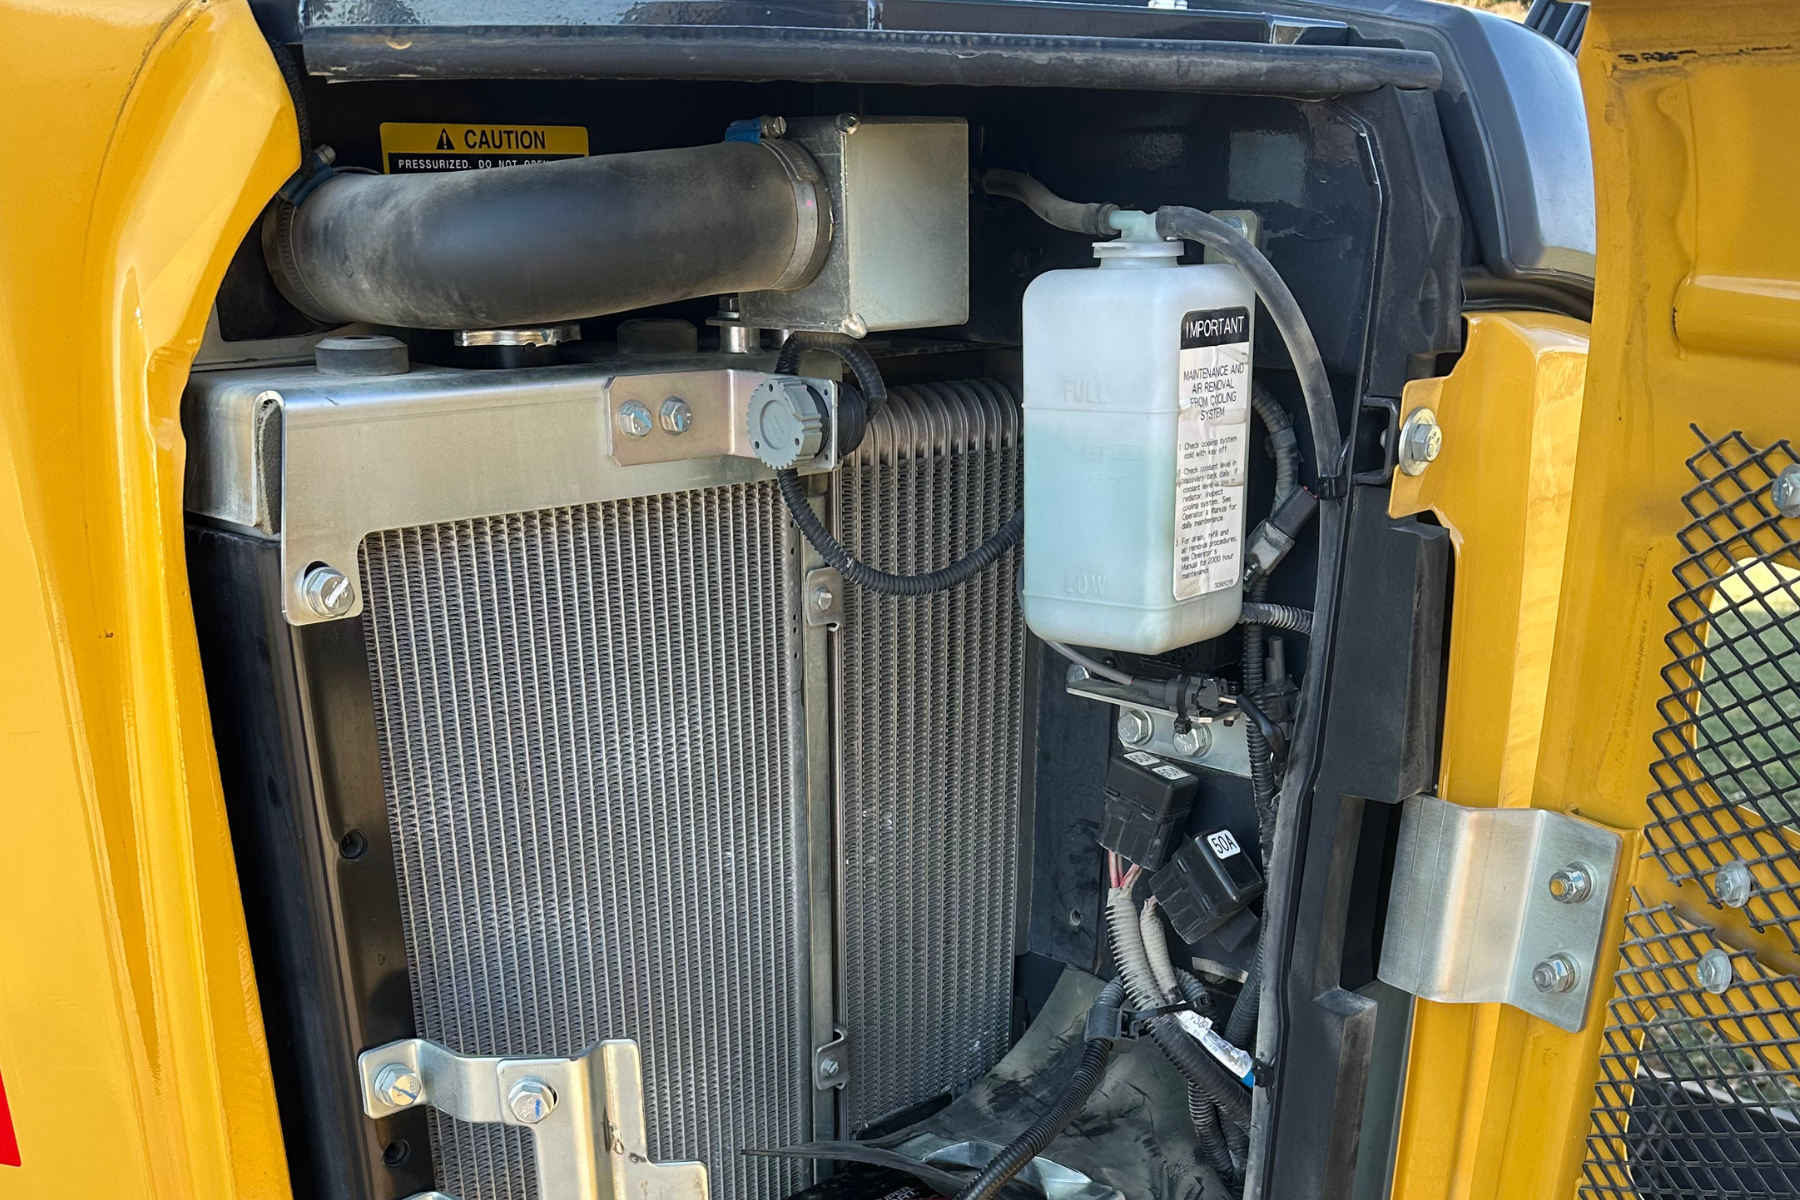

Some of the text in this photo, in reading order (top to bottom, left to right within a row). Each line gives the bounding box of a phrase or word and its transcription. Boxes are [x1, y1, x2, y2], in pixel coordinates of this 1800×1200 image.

[464, 129, 546, 149] CAUTION
[398, 159, 472, 169] PRESSURIZED.
[478, 160, 492, 169] DO
[498, 160, 518, 168] NOT
[1185, 316, 1244, 339] IMPORTANT
[1183, 363, 1244, 381] MAINTENANCE AND
[1063, 379, 1107, 404] FULL
[1192, 378, 1235, 394] AIR REMOVAL
[1190, 391, 1236, 408] FROM COOLING
[1200, 408, 1225, 421] SYSTEM
[1184, 442, 1199, 450] Check
[1201, 438, 1218, 447] cooling
[1220, 436, 1237, 444] system
[1184, 451, 1194, 459] cold
[1196, 449, 1206, 457] with
[1183, 467, 1198, 475] Check
[1200, 463, 1218, 472] coolant
[1183, 484, 1200, 494] coolant
[1182, 502, 1199, 512] cooling
[1211, 505, 1227, 514] Manual
[1182, 521, 1192, 529] daily
[1181, 537, 1190, 545] For
[1220, 528, 1229, 537] and
[1181, 561, 1197, 571] Manual
[1208, 555, 1221, 565] 2000
[1222, 553, 1234, 561] hour
[1065, 573, 1106, 597] LOW
[1210, 833, 1238, 854] 50A
